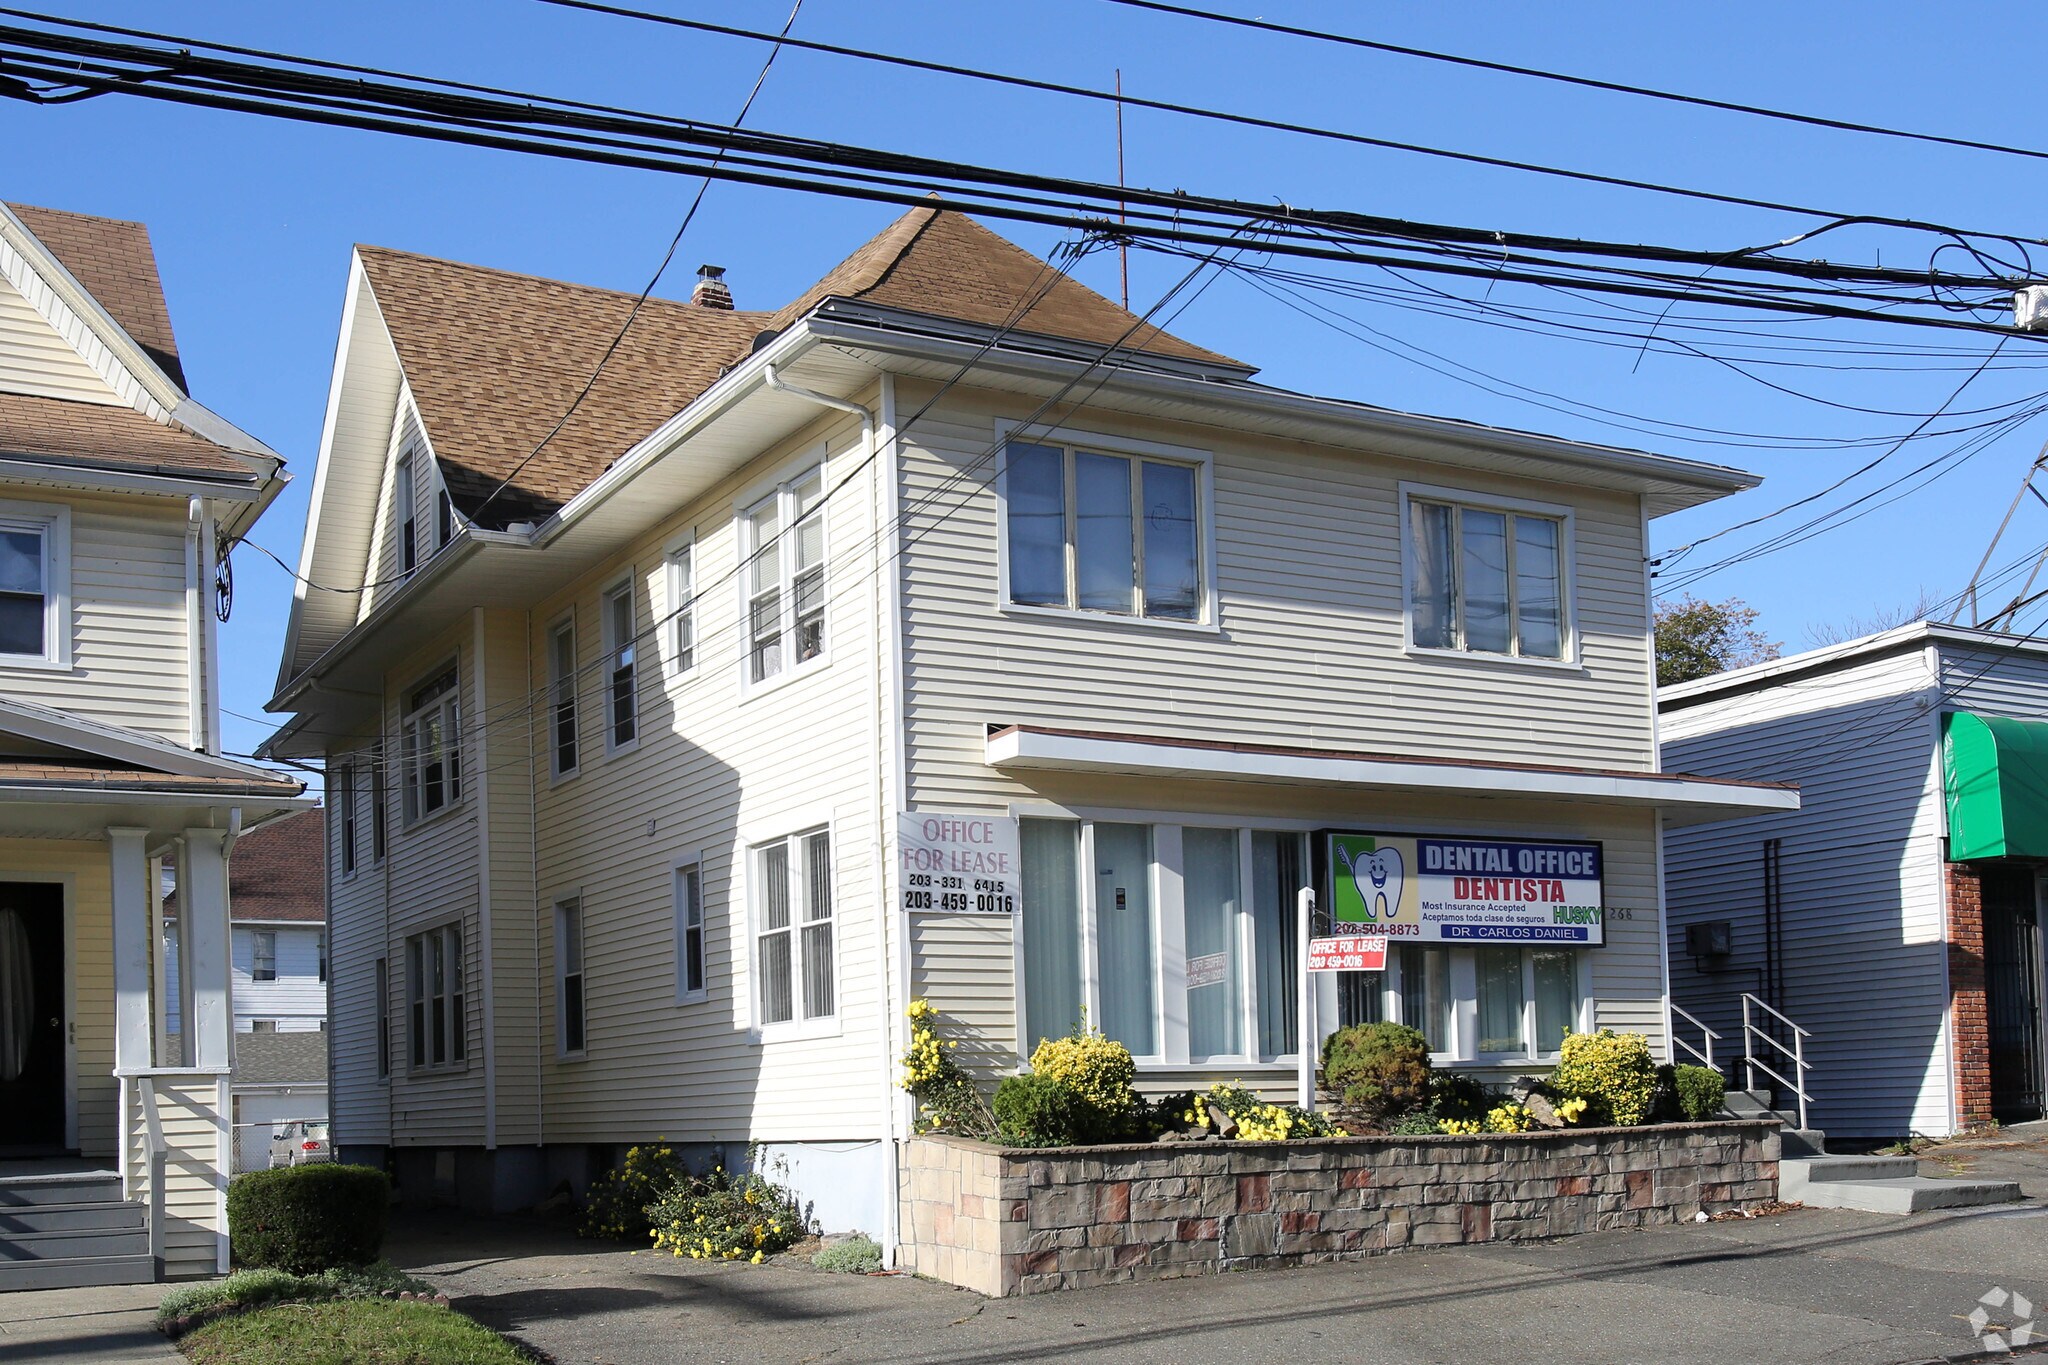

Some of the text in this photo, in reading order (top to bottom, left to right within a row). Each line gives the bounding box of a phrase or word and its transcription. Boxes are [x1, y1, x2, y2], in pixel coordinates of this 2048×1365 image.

[922, 818, 994, 844] OFFICE
[903, 847, 1009, 874] FOR LEASE
[1425, 845, 1594, 875] DENTAL OFFICE
[909, 873, 1004, 893] 203-331 6415
[1453, 876, 1566, 903] DENTISTA
[905, 890, 1012, 912] 203-459-0016
[1422, 901, 1526, 914] Most Insurance Accepted
[1422, 912, 1546, 925] Aceptamos toda clase de seguros
[1552, 905, 1601, 925] HUSKY
[1610, 907, 1632, 920] 268
[1451, 926, 1579, 940] DR. CARLOS DANIEL
[1312, 939, 1384, 955] OFFICE FOR LEASE
[1309, 955, 1363, 969] 203 459-0016
